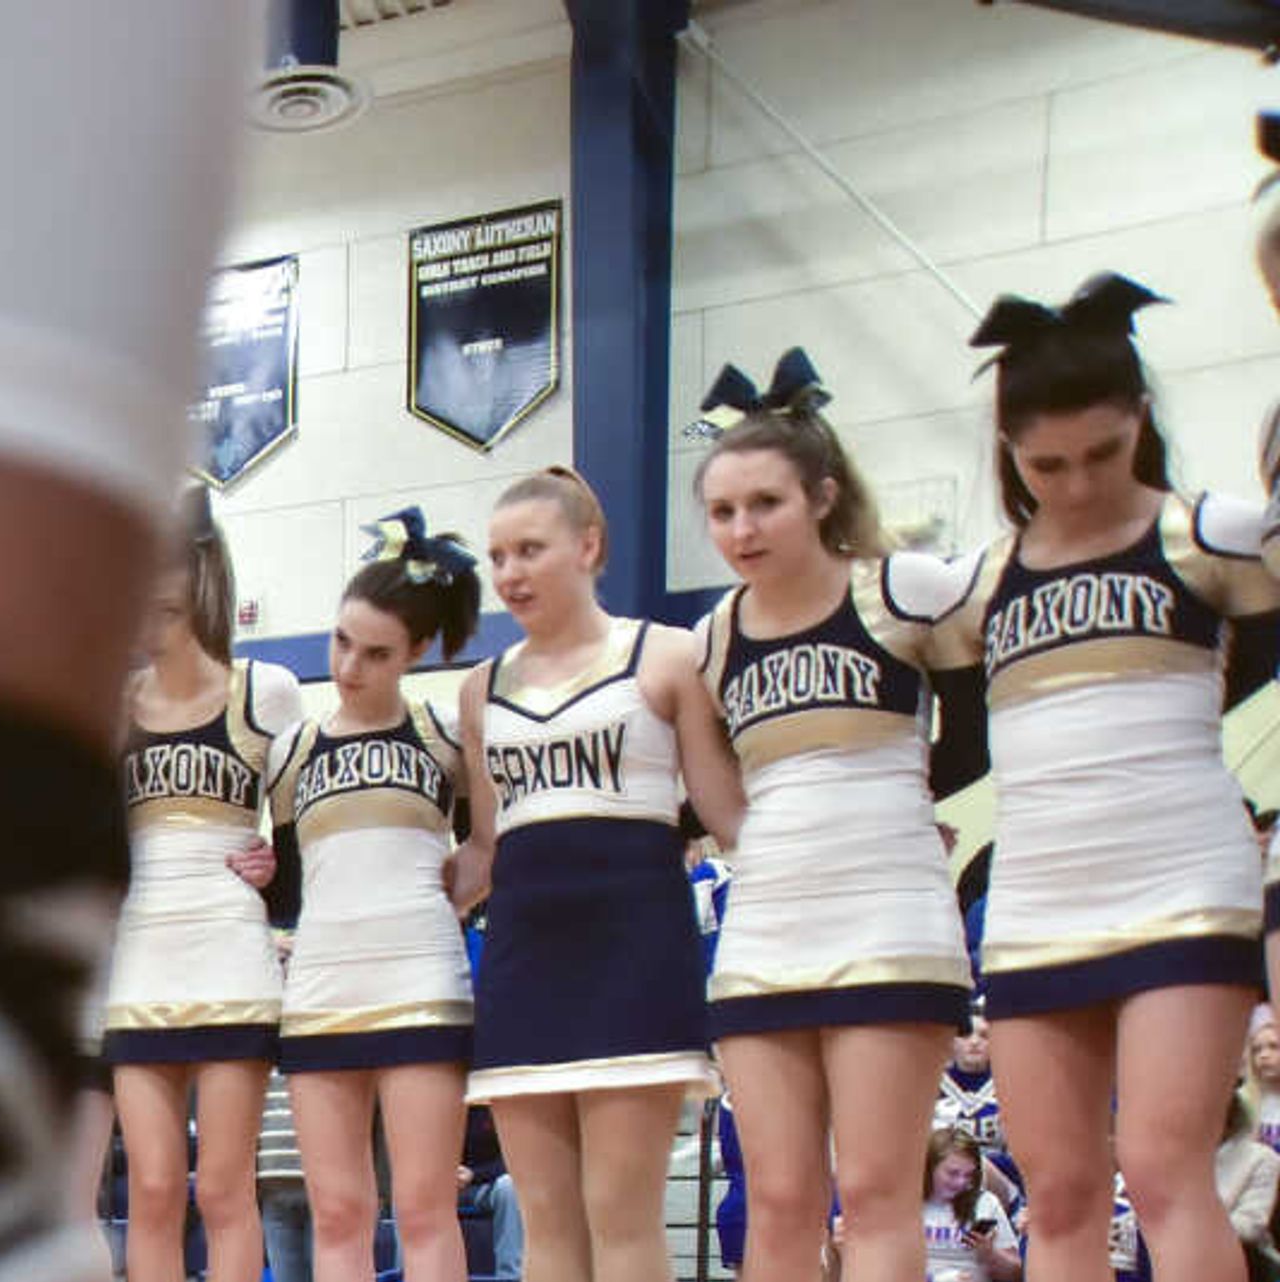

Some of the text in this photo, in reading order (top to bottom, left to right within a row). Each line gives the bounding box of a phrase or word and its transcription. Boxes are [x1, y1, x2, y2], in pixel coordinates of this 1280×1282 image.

[412, 228, 472, 260] SAXONY
[985, 572, 1175, 678] SAXONY
[723, 642, 881, 738] SAXONY
[295, 739, 442, 820] SAXONY
[487, 722, 627, 812] SAXONY
